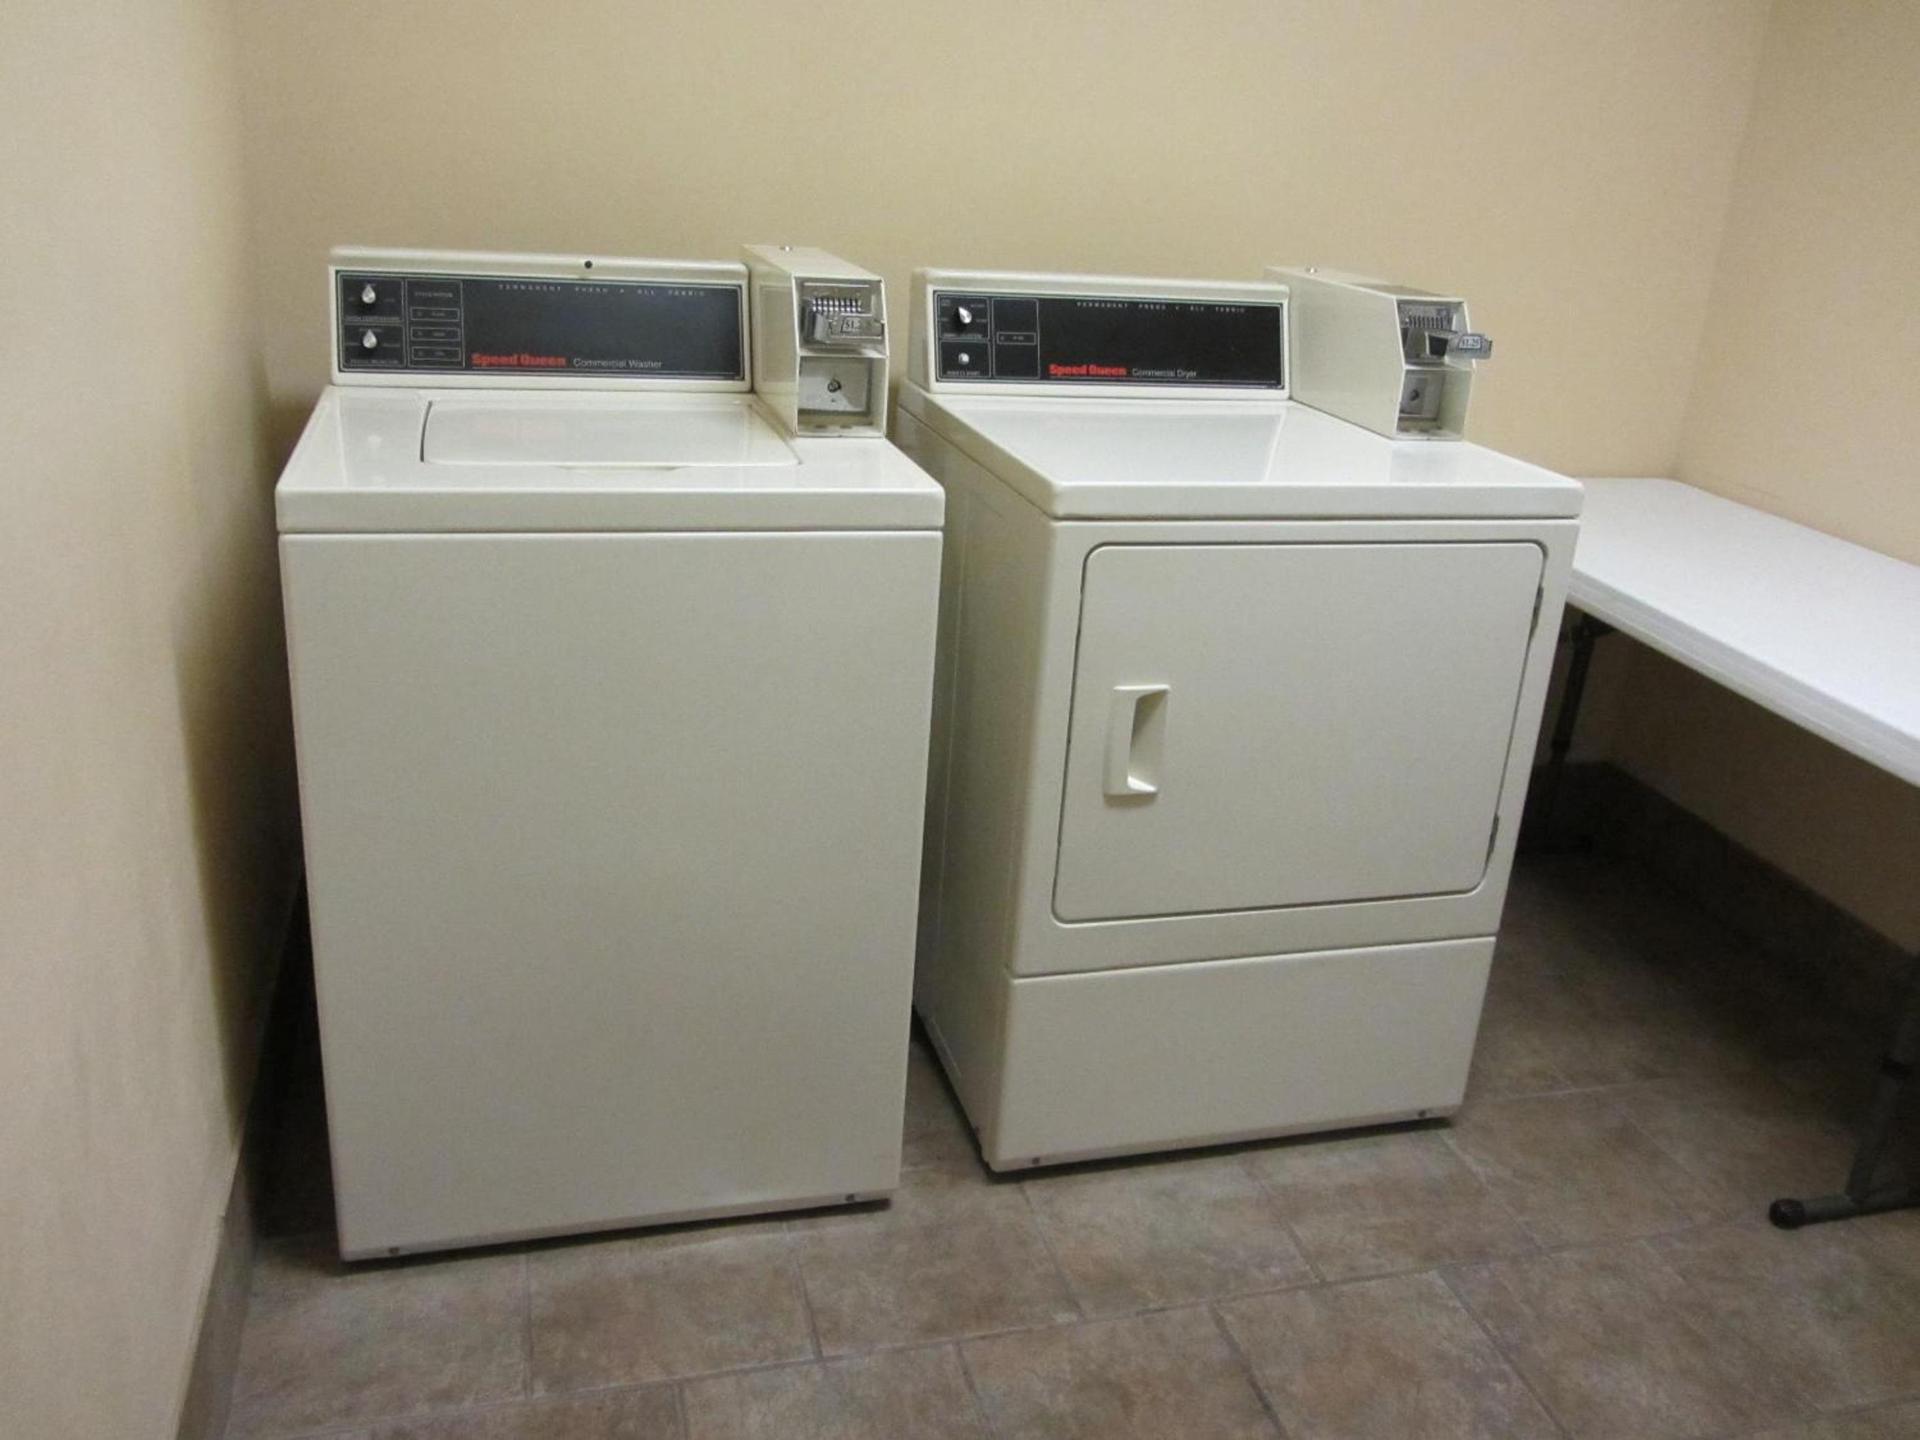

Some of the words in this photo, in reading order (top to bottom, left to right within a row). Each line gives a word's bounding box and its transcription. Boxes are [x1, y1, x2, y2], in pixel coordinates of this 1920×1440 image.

[471, 353, 518, 367] Speed
[519, 353, 567, 367] Queen
[573, 357, 626, 368] Commercial
[628, 359, 663, 370] Washer
[1048, 363, 1088, 376] Speed
[1089, 364, 1127, 377] Queen
[1132, 367, 1176, 377] Commercial
[1177, 369, 1197, 380] Dryer
